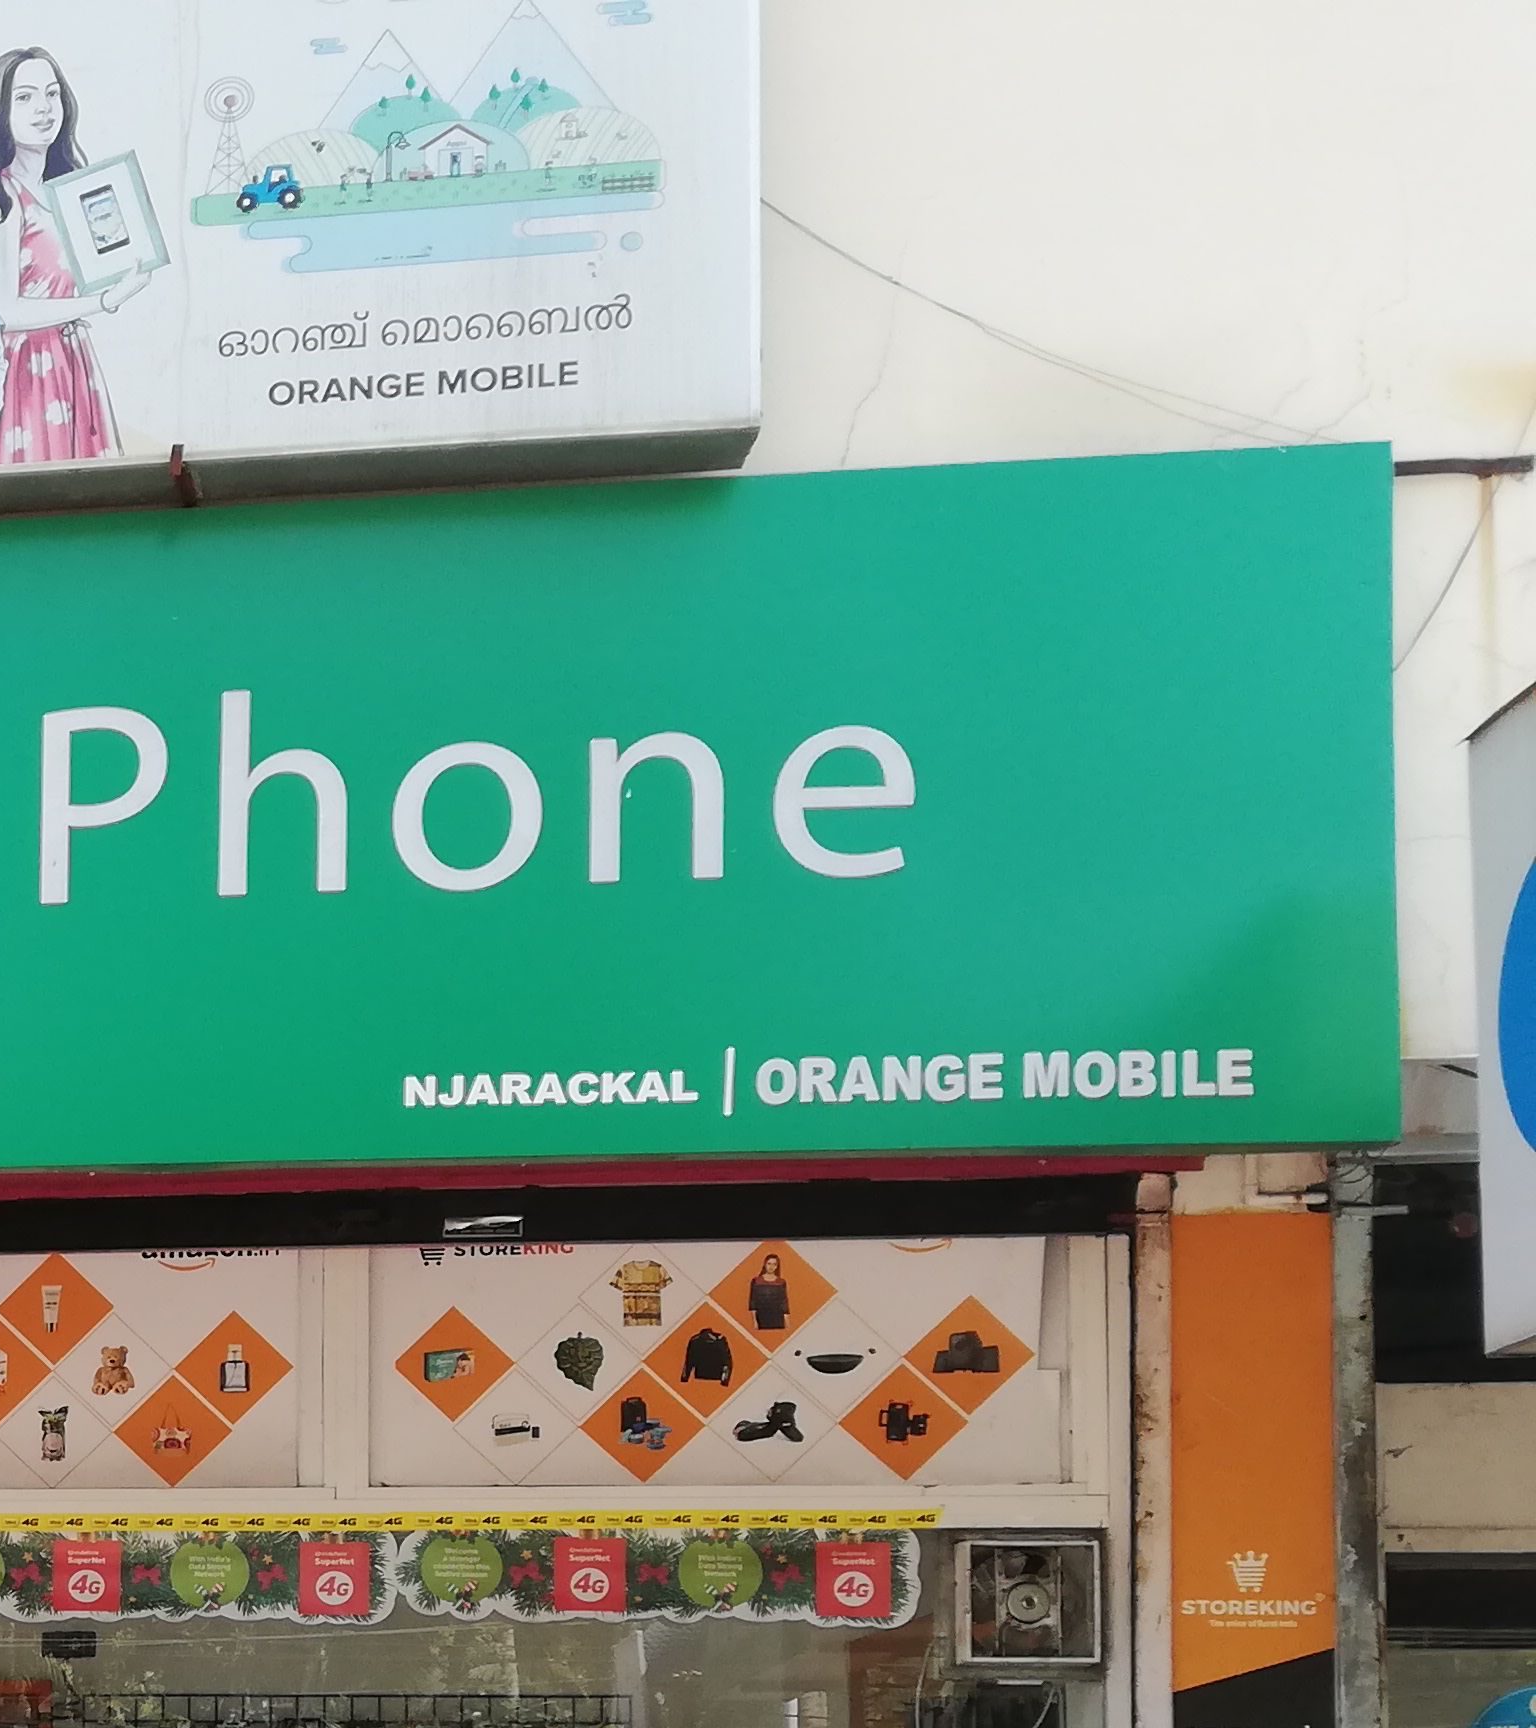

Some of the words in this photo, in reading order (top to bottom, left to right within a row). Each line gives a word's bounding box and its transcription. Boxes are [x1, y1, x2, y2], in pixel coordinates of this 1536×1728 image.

[218, 310, 370, 358] ഓറഞ്ച്
[381, 293, 633, 347] മൊബൈൽ
[267, 372, 425, 406] ORANGE
[437, 361, 579, 395] MOBILE
[36, 689, 922, 905] Phone
[402, 1069, 699, 1107] NJARACKAL
[754, 1050, 1005, 1107] ORANGE
[1022, 1048, 1256, 1101] MOBILE
[71, 1574, 100, 1595] 4G
[319, 1576, 350, 1596] 4G
[573, 1573, 606, 1594] 4G
[837, 1576, 870, 1598] 4G
[1181, 1599, 1317, 1616] STOREKING
